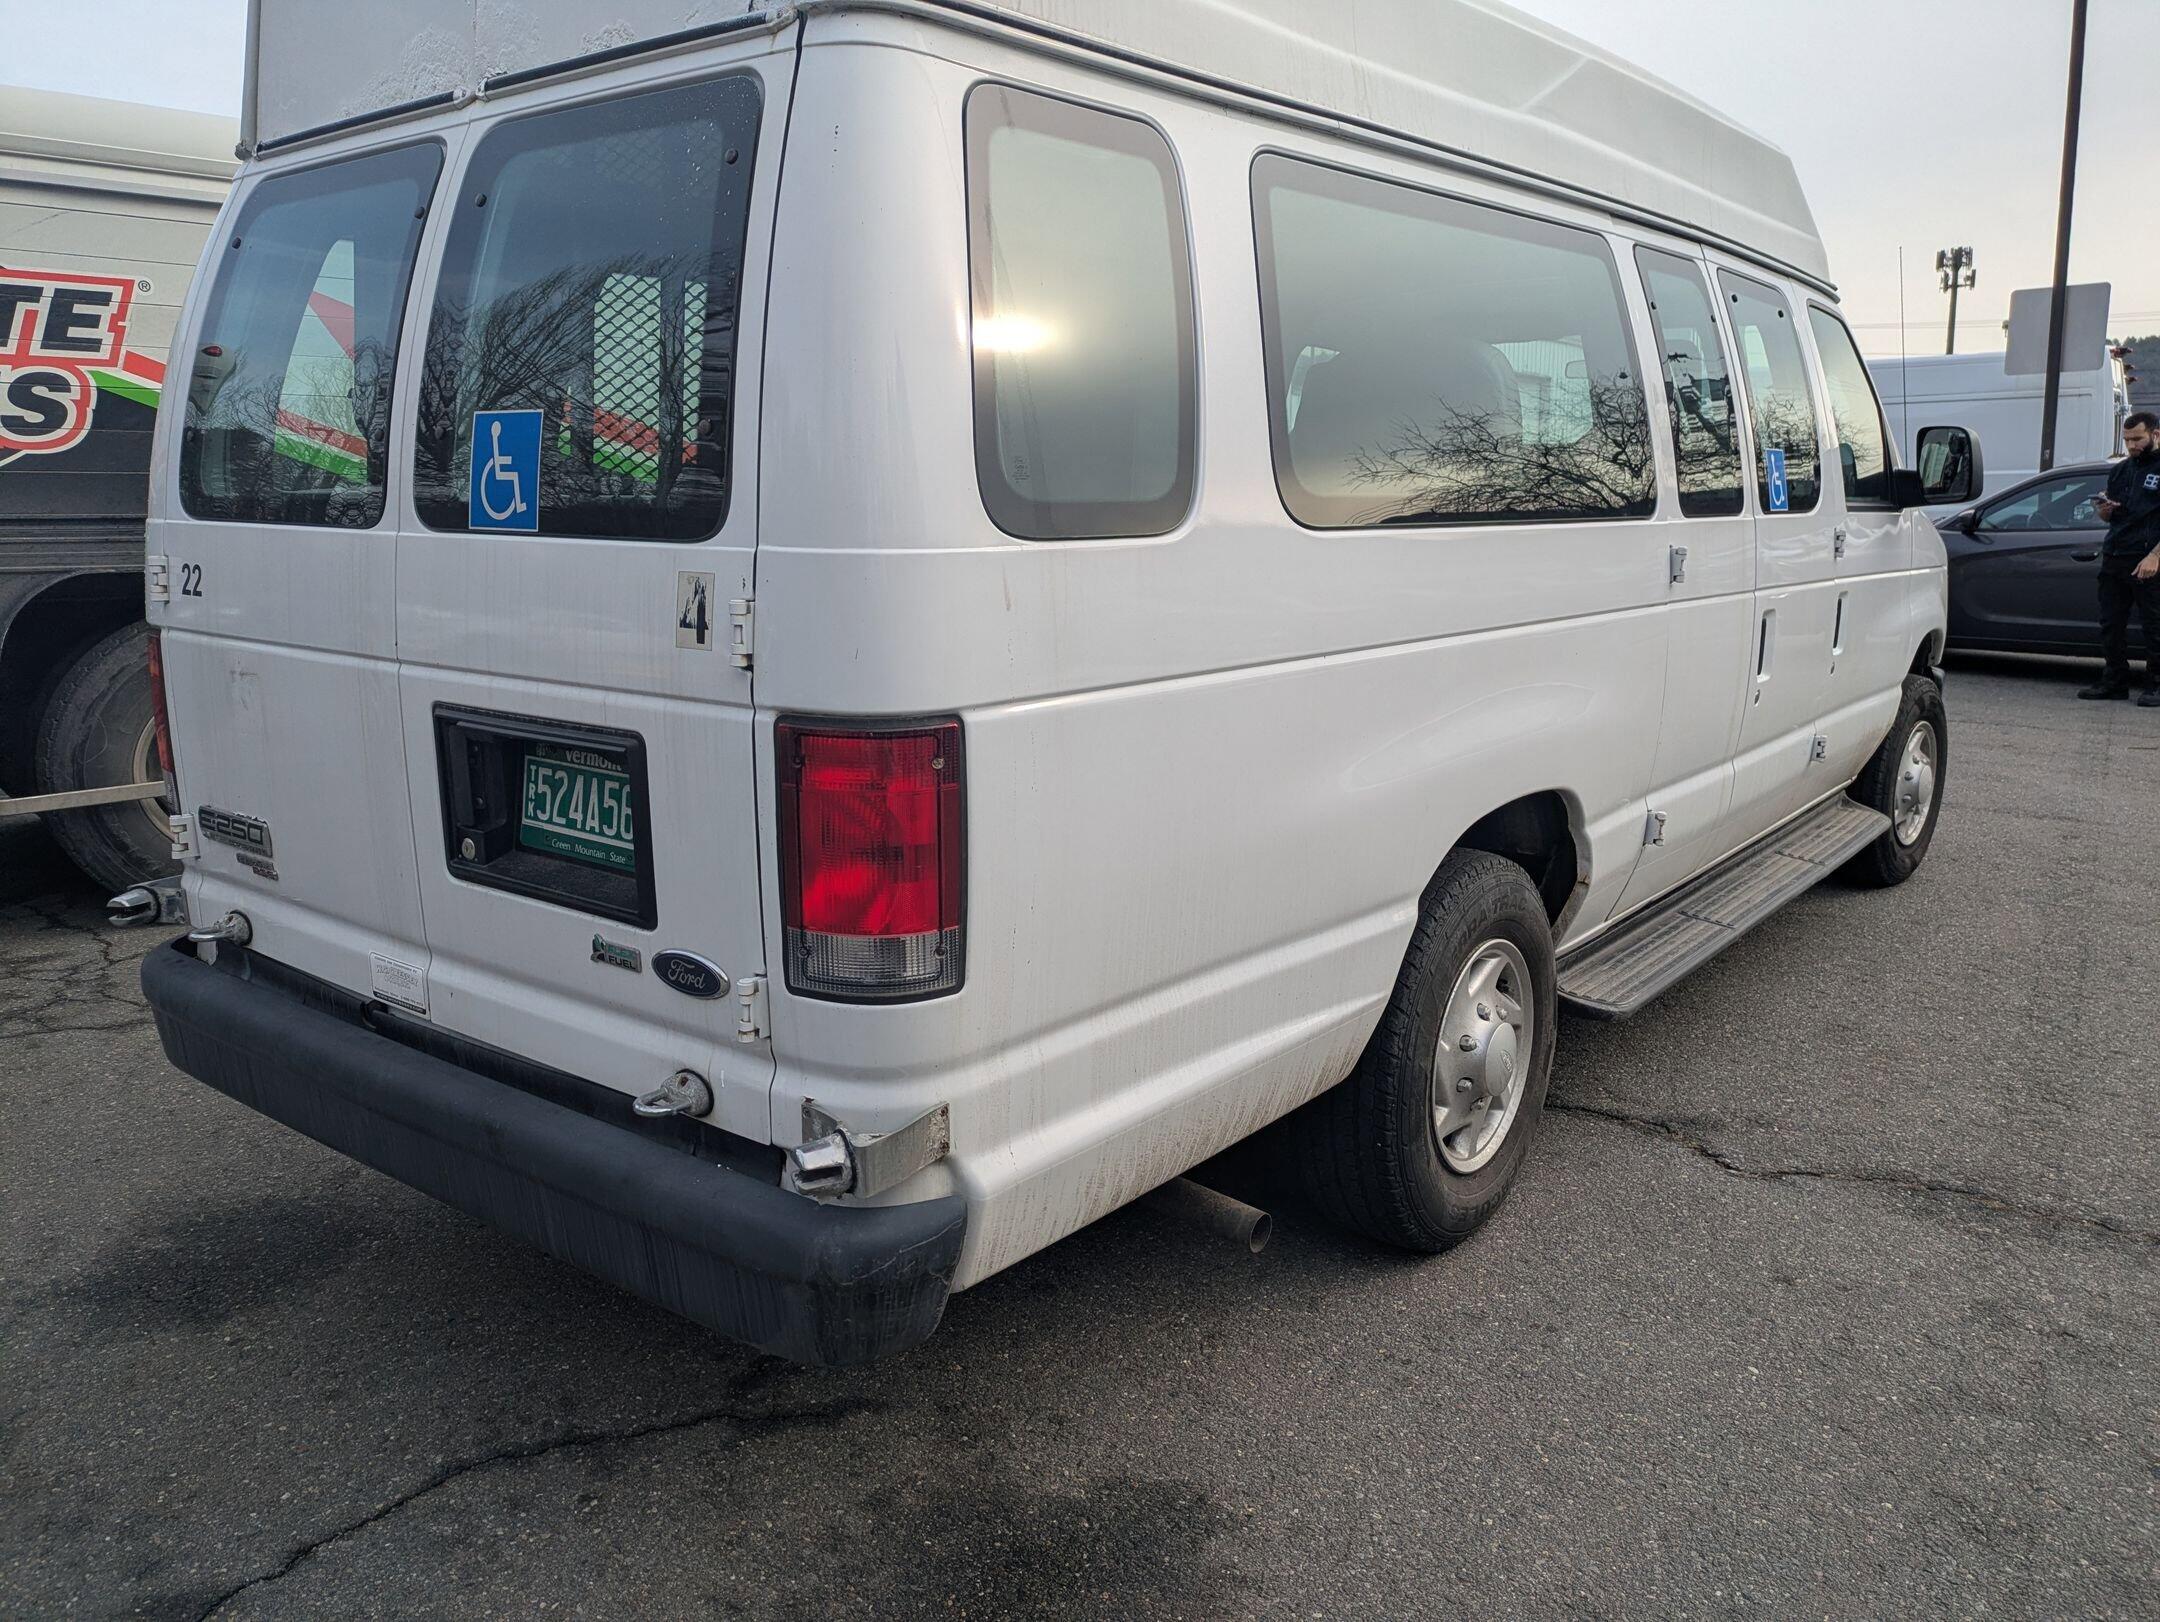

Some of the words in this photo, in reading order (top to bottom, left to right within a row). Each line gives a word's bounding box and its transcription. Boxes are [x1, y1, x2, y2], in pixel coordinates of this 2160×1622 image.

[181, 563, 203, 597] 22
[536, 766, 634, 840] 524A56
[551, 838, 571, 850] Green
[574, 843, 606, 860] Mountain
[609, 851, 626, 865] State
[608, 955, 637, 971] FUEL
[667, 958, 707, 989] Ford
